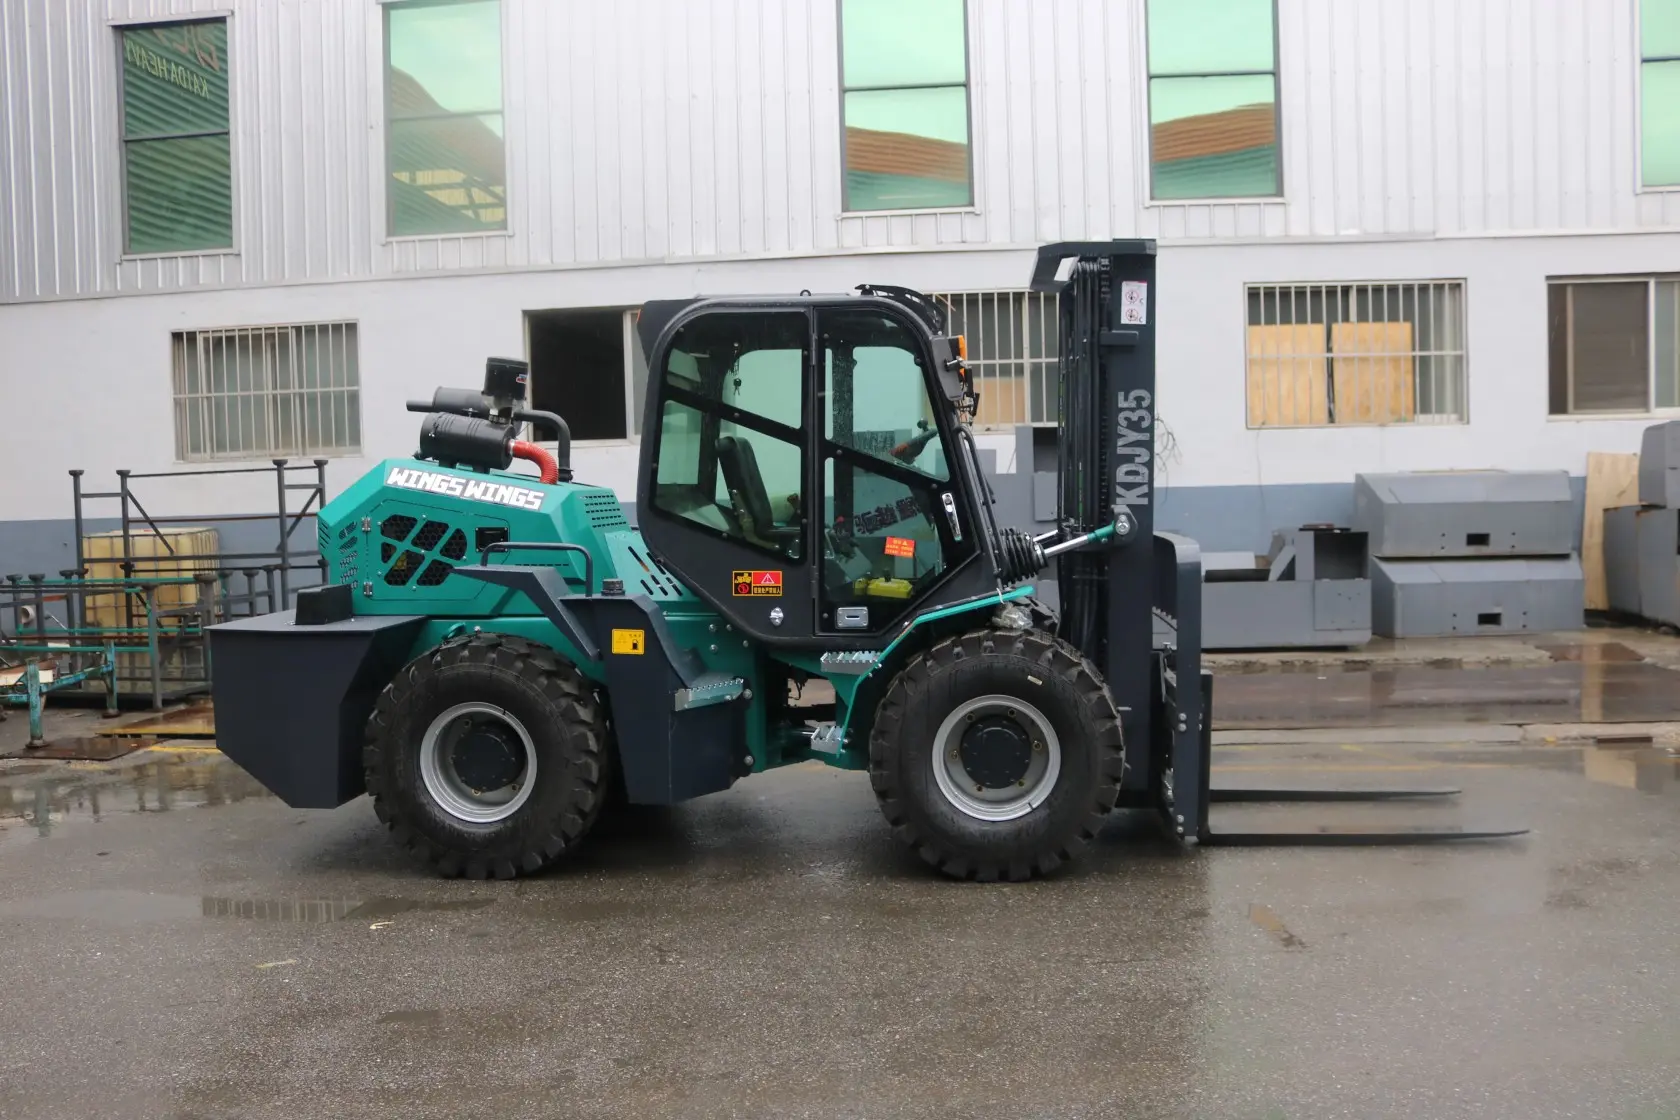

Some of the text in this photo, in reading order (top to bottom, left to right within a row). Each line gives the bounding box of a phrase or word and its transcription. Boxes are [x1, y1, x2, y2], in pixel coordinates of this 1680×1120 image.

[1115, 388, 1152, 505] KDJY35
[386, 467, 545, 510] WINGS WINGS
